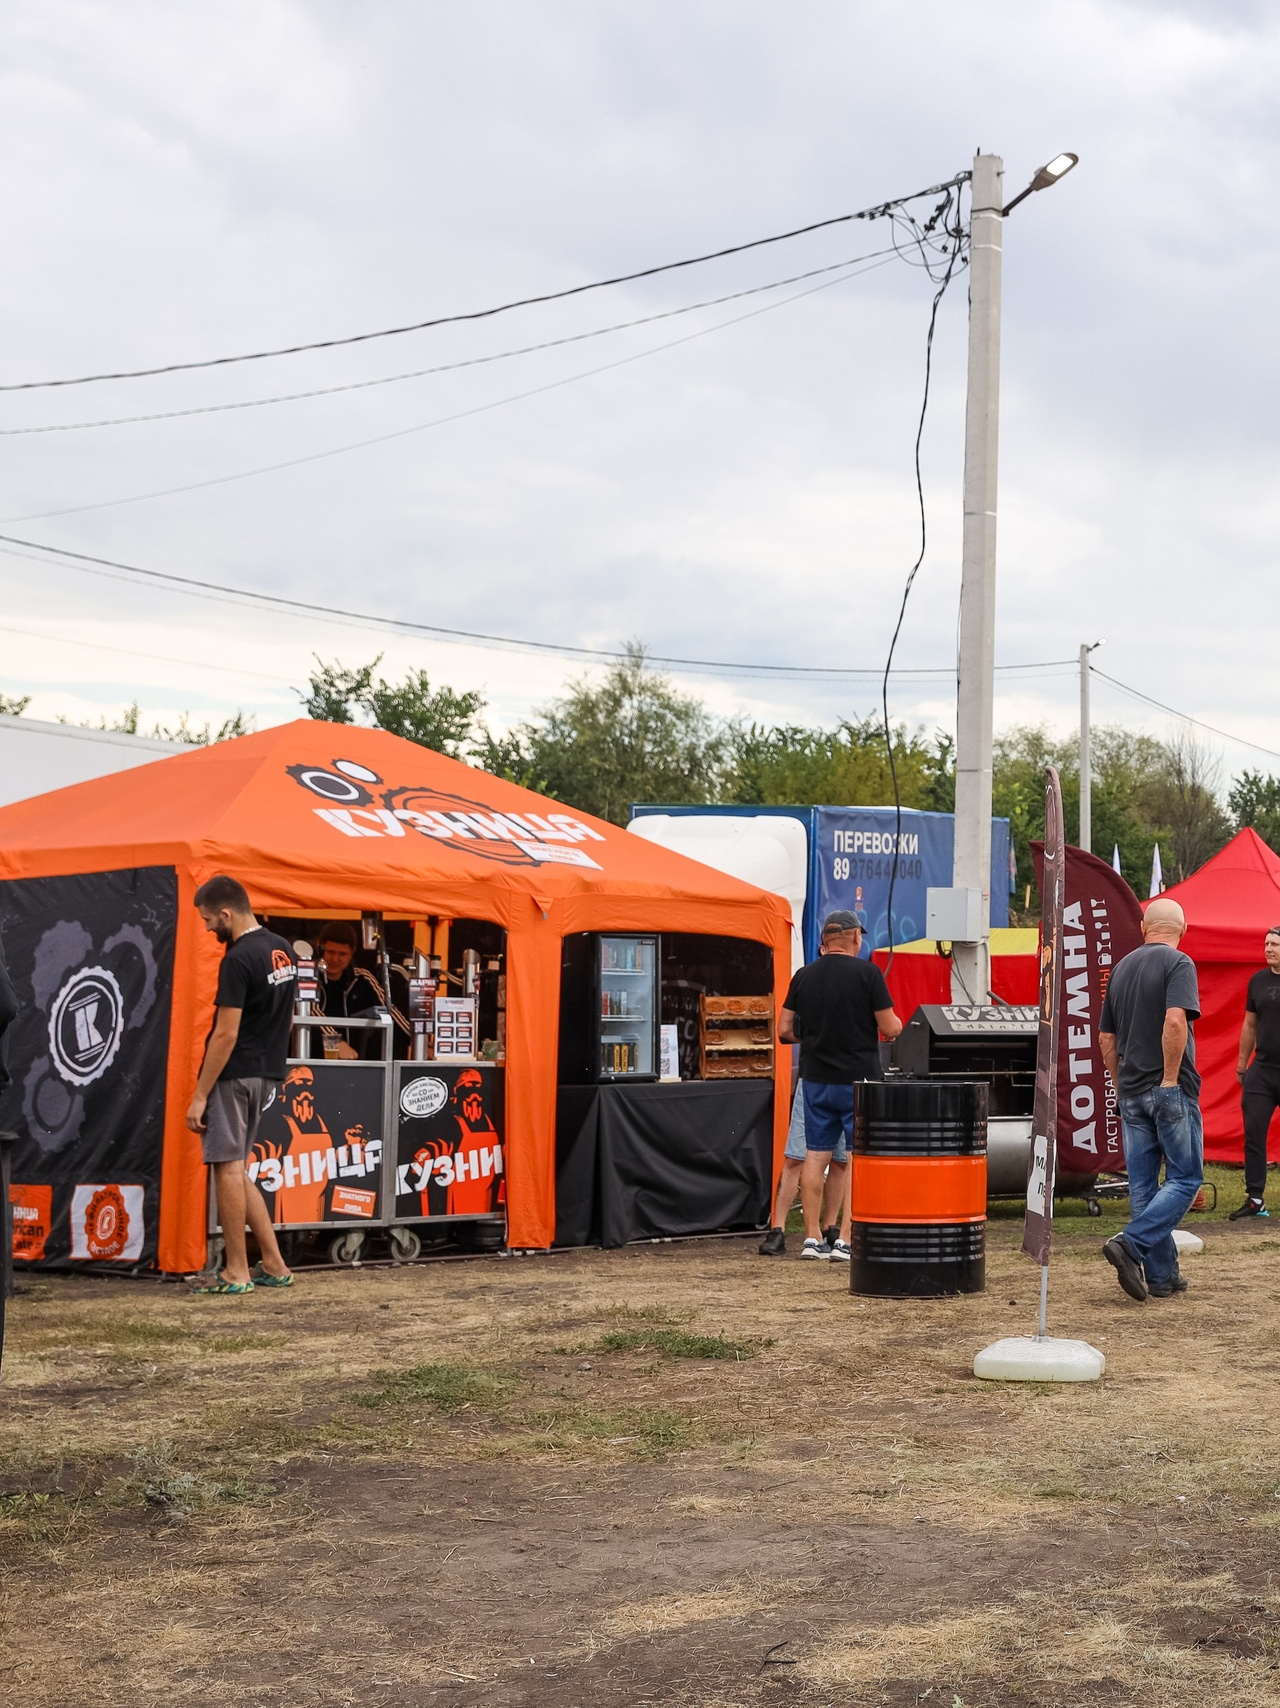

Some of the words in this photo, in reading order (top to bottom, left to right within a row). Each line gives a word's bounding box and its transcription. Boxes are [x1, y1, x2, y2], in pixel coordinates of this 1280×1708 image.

[312, 808, 607, 843] КУЗНИЦА
[833, 829, 919, 855] ПЕРЕВОЗКИ
[941, 1006, 1040, 1021] КУЗНИ
[1063, 900, 1099, 1154] ДОТЕМНА
[408, 1092, 440, 1106] ЗНАНИЕМ
[418, 1088, 428, 1096] СО
[416, 1101, 435, 1112] ДЕЛА
[1104, 1069, 1119, 1153] ГАСТРОБАР
[245, 1139, 383, 1193] УЗНИЦА
[395, 1144, 503, 1196] КУЗНИ
[13, 1206, 39, 1221] НИЦА
[13, 1224, 44, 1237] rican
